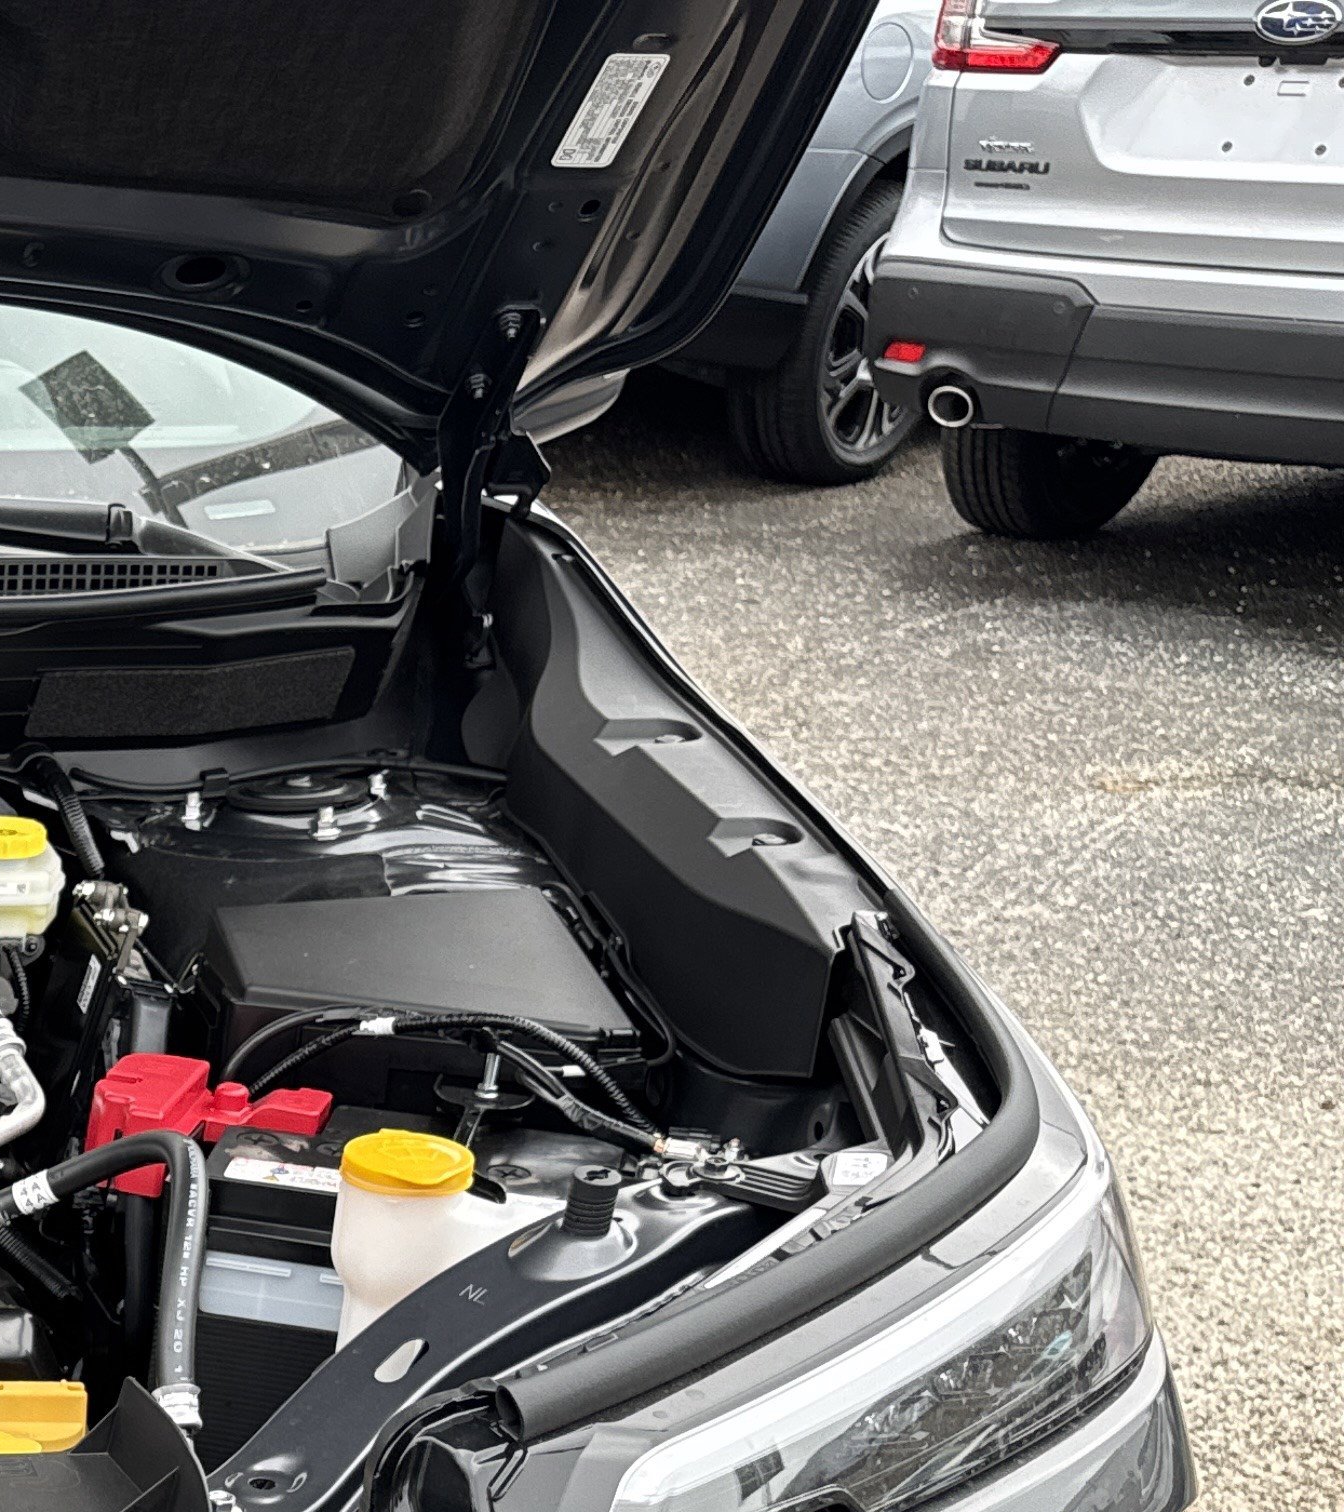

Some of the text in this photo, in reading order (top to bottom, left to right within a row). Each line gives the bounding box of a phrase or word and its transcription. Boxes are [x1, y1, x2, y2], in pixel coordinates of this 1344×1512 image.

[963, 158, 1050, 175] SUBARU
[458, 1283, 488, 1306] NL
[175, 1297, 187, 1322] XJ
[173, 1328, 184, 1354] 20
